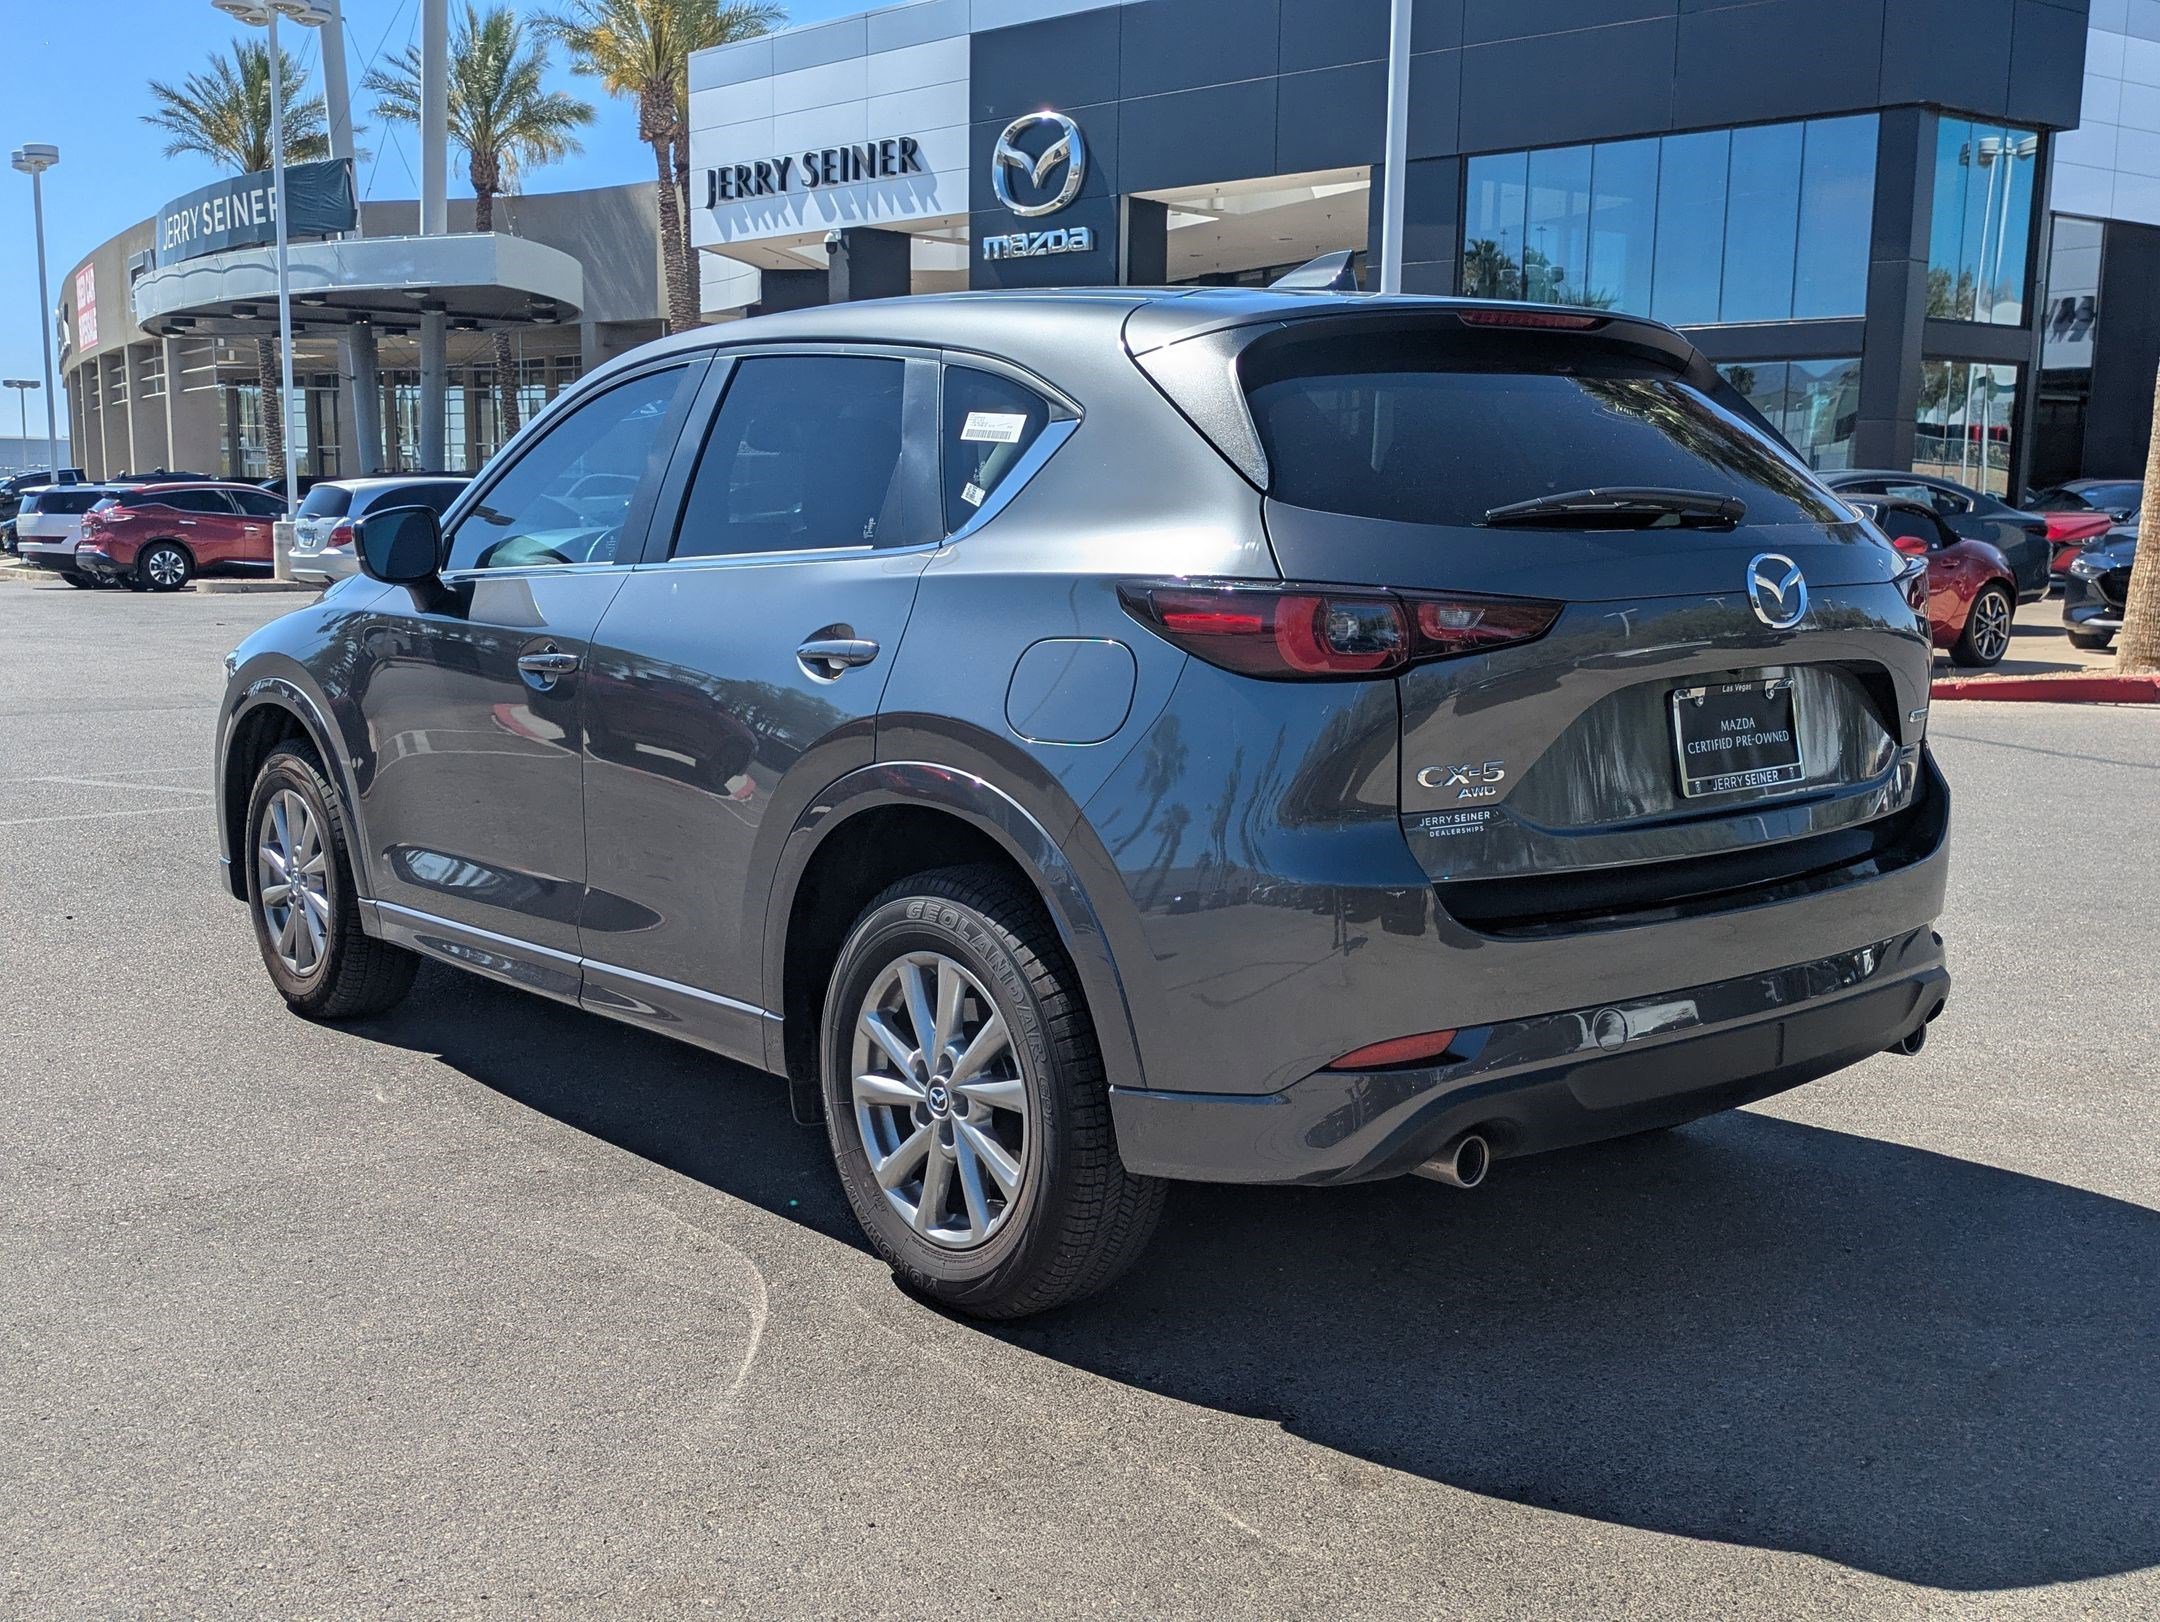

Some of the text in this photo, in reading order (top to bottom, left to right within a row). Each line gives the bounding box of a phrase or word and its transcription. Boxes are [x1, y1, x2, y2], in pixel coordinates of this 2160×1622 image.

[705, 136, 922, 209] JERRY SEINER
[163, 206, 199, 251] JERRY
[1722, 683, 1752, 693] Las Vegas
[1720, 717, 1756, 732] MAZDA
[1687, 730, 1790, 755] CERTIFIED PRE-OWNED
[1417, 760, 1505, 788] CX-5
[1712, 770, 1779, 791] JERRY SEINER
[1457, 786, 1497, 799] AWD
[1420, 811, 1490, 827] JERRY SEINER
[1429, 826, 1485, 838] DEALERSHIPS
